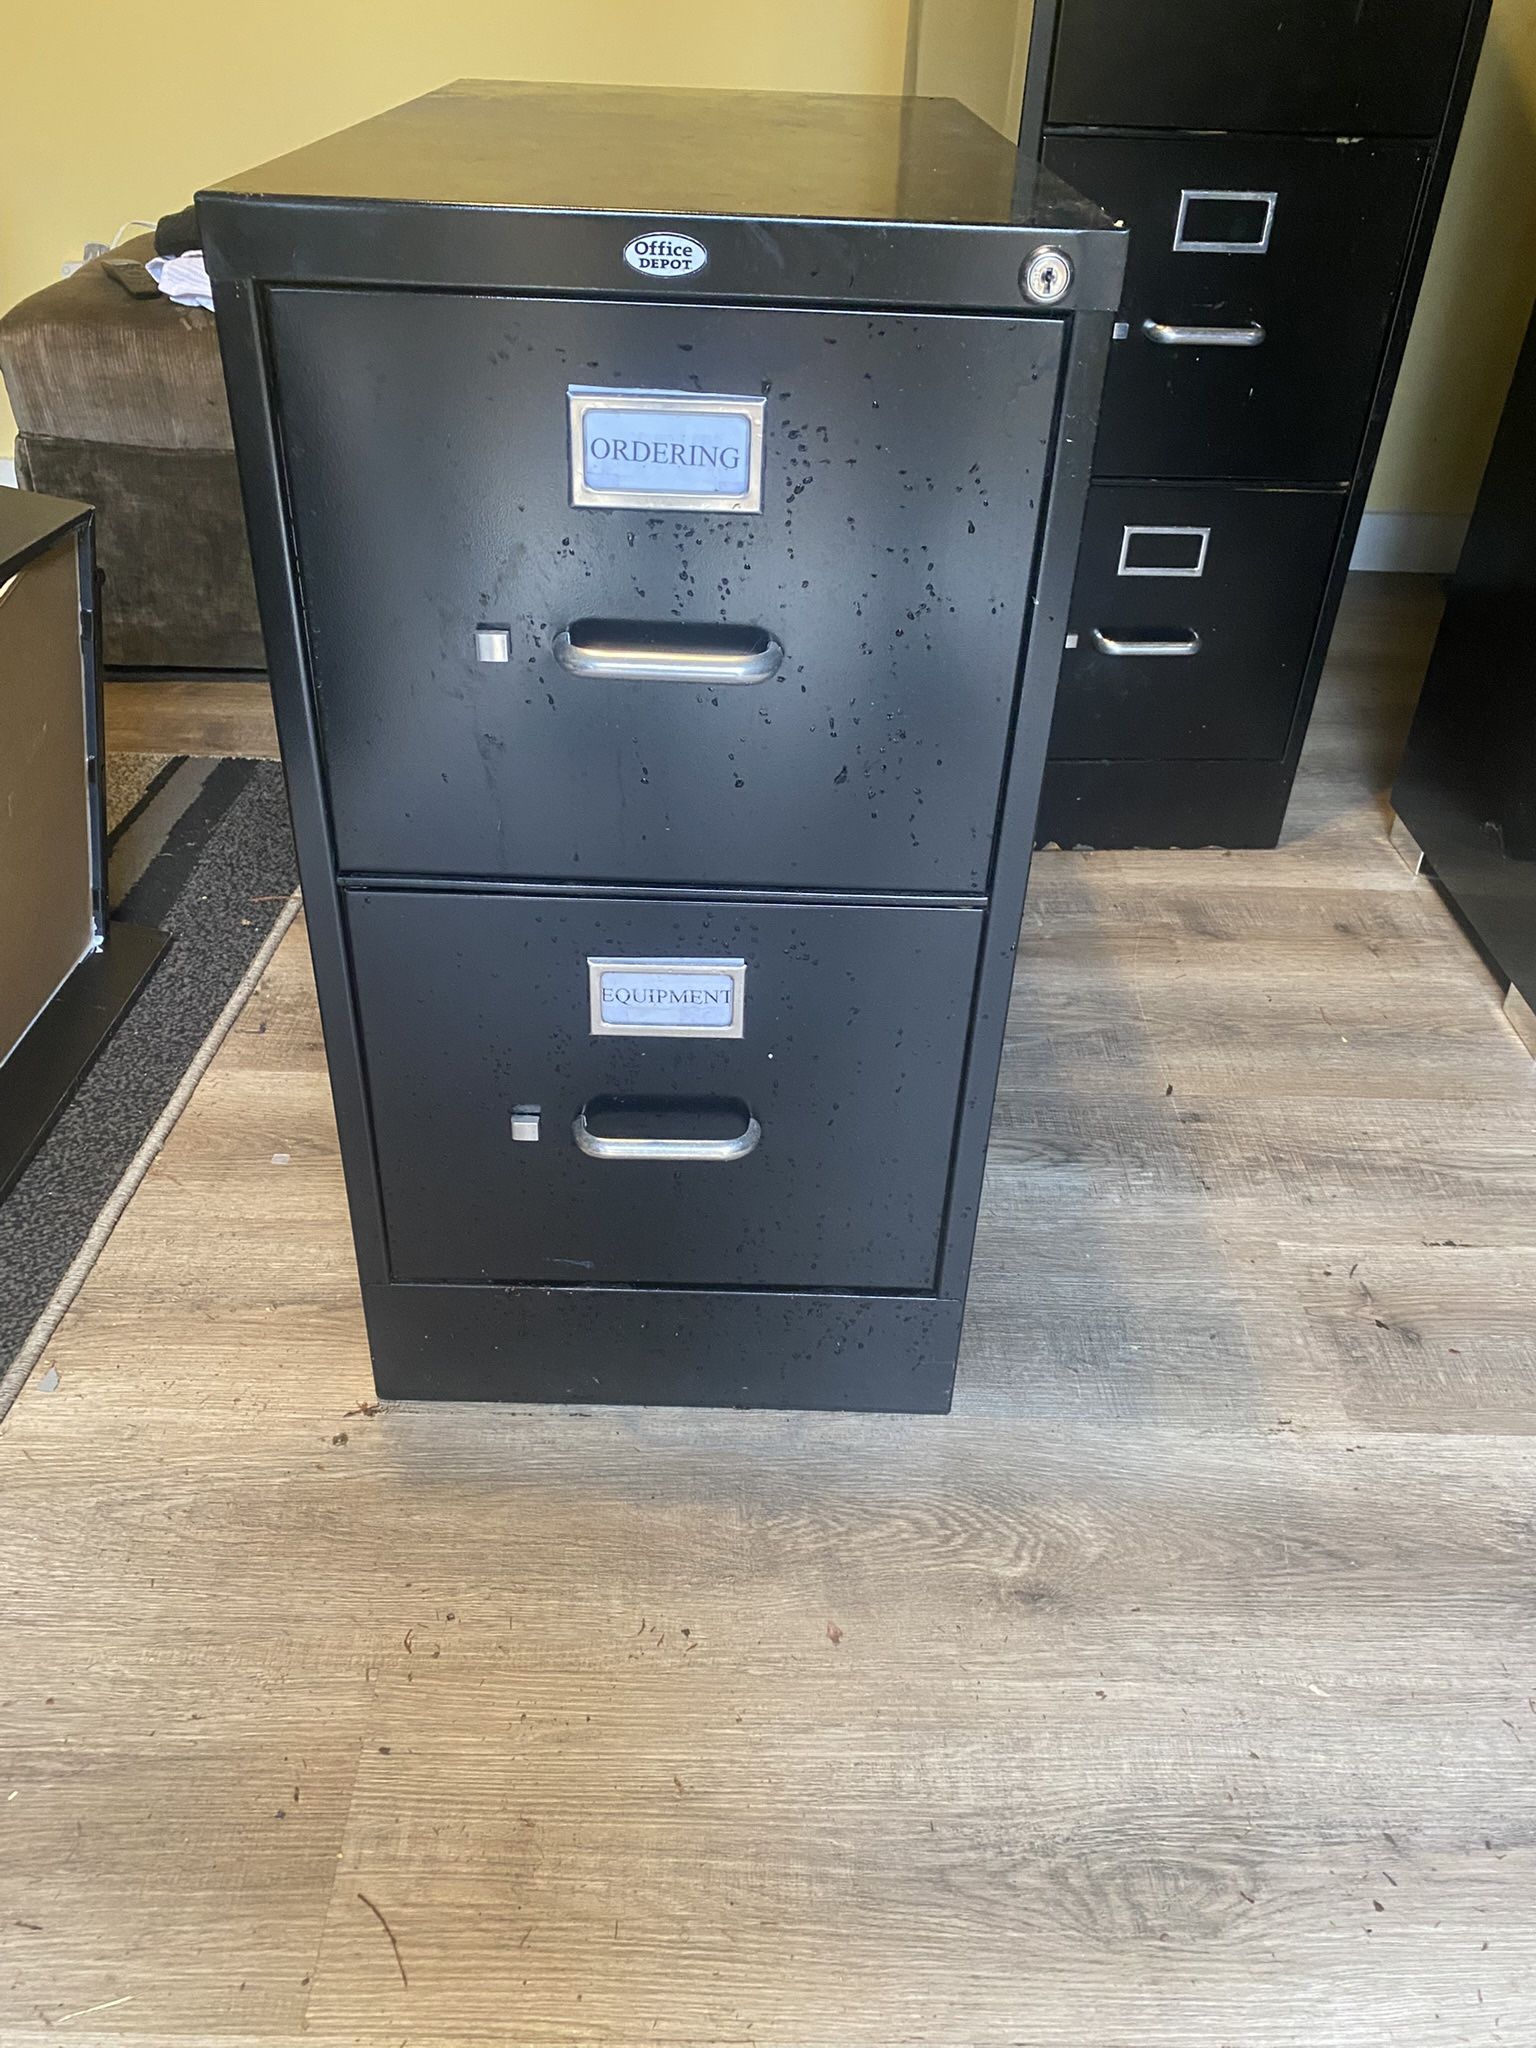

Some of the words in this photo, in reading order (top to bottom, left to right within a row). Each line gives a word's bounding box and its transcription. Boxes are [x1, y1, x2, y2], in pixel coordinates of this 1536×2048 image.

[634, 240, 693, 257] Office
[639, 258, 693, 270] DEPOT
[590, 437, 740, 470] ORDERING
[601, 987, 731, 1005] EQUIPMENT
